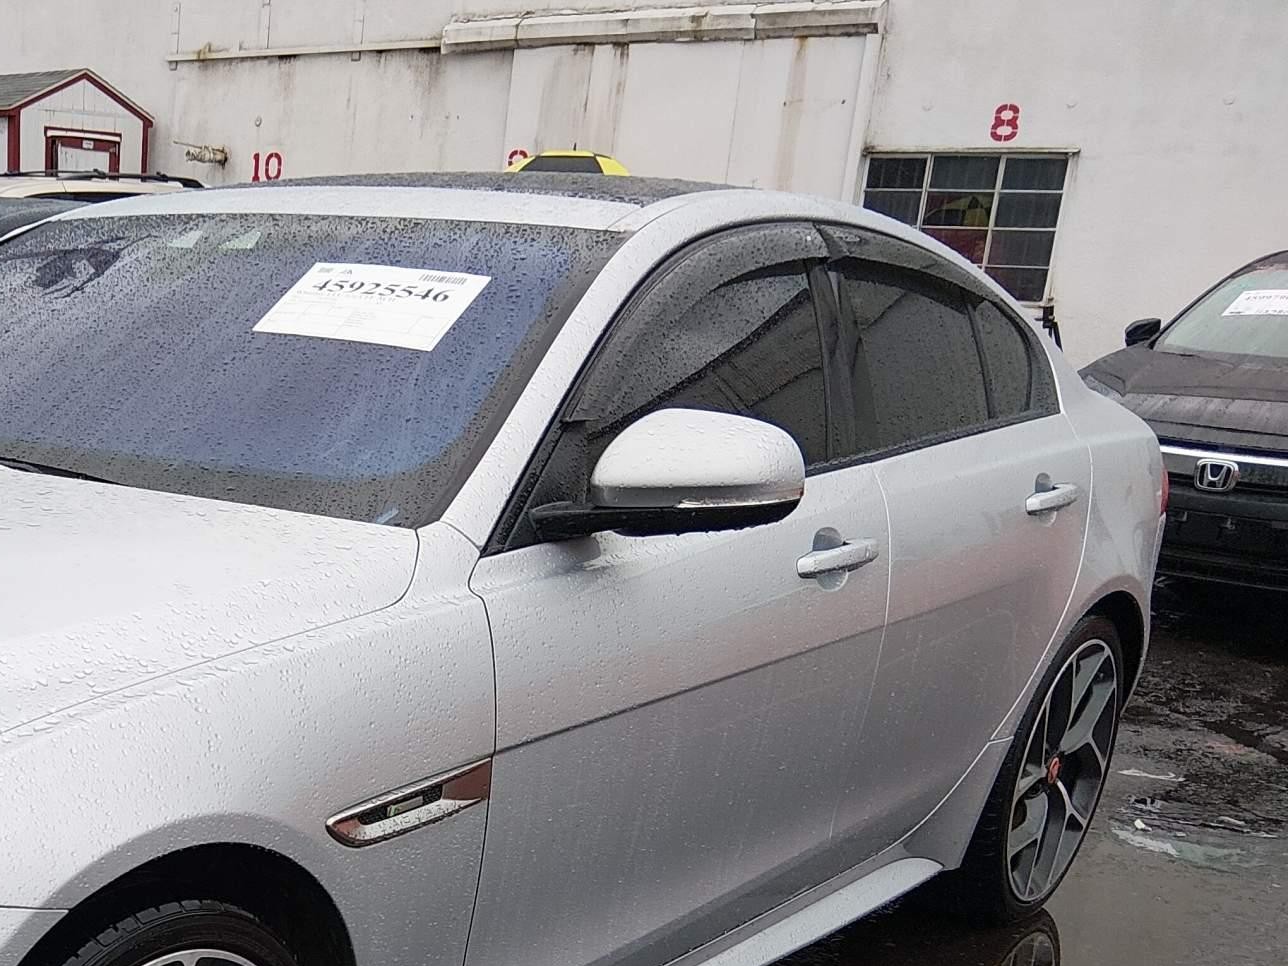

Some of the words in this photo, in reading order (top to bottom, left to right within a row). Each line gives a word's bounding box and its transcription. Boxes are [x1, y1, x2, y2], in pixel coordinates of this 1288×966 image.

[990, 103, 1020, 142] 8
[252, 152, 282, 182] 10
[312, 278, 455, 303] 45925546
